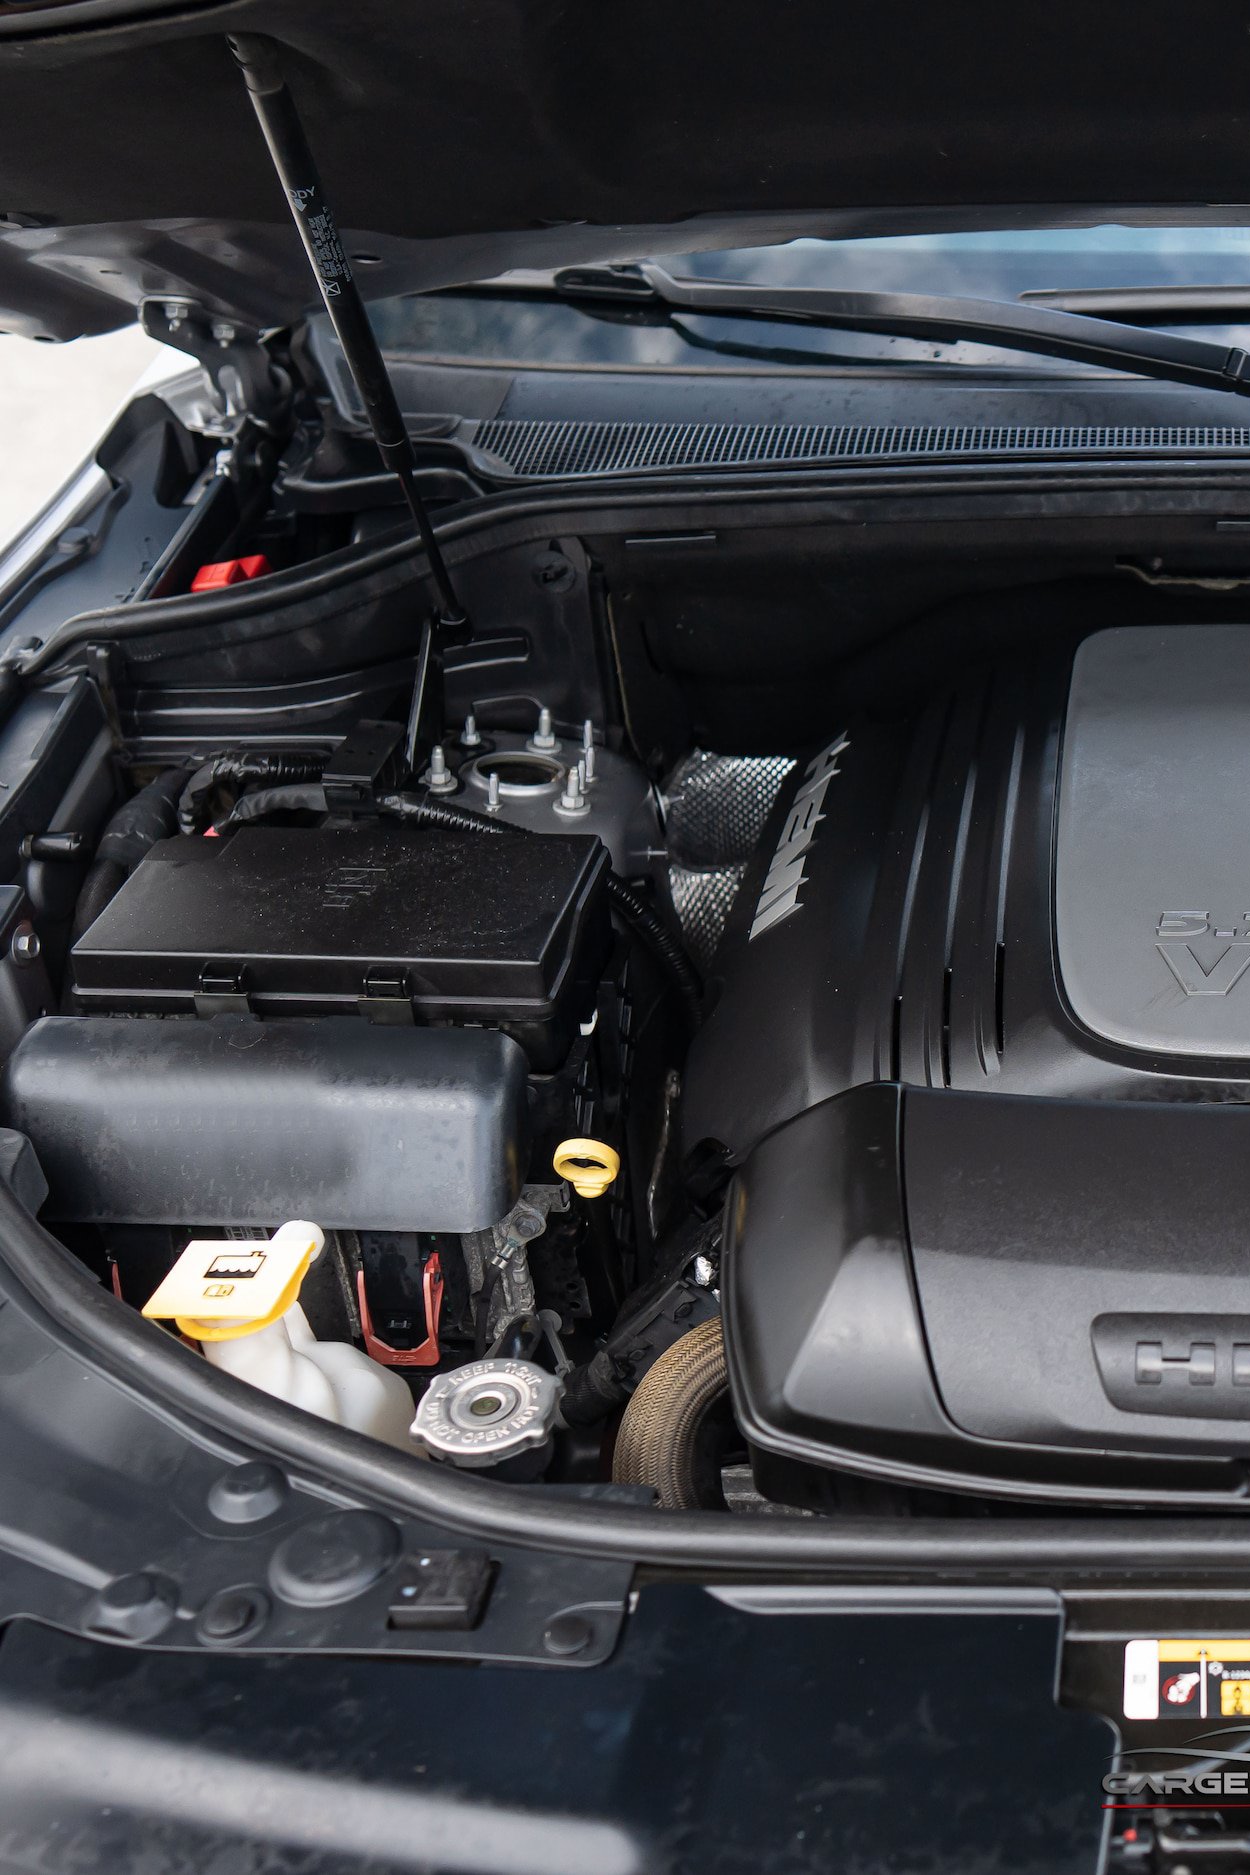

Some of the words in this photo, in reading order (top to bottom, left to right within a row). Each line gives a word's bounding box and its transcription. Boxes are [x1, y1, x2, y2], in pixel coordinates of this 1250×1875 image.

[289, 186, 315, 199] ODY
[748, 730, 850, 942] HEMI
[448, 1362, 495, 1387] KEEP
[504, 1362, 542, 1385] TIGHT
[461, 1426, 511, 1444] OPEN
